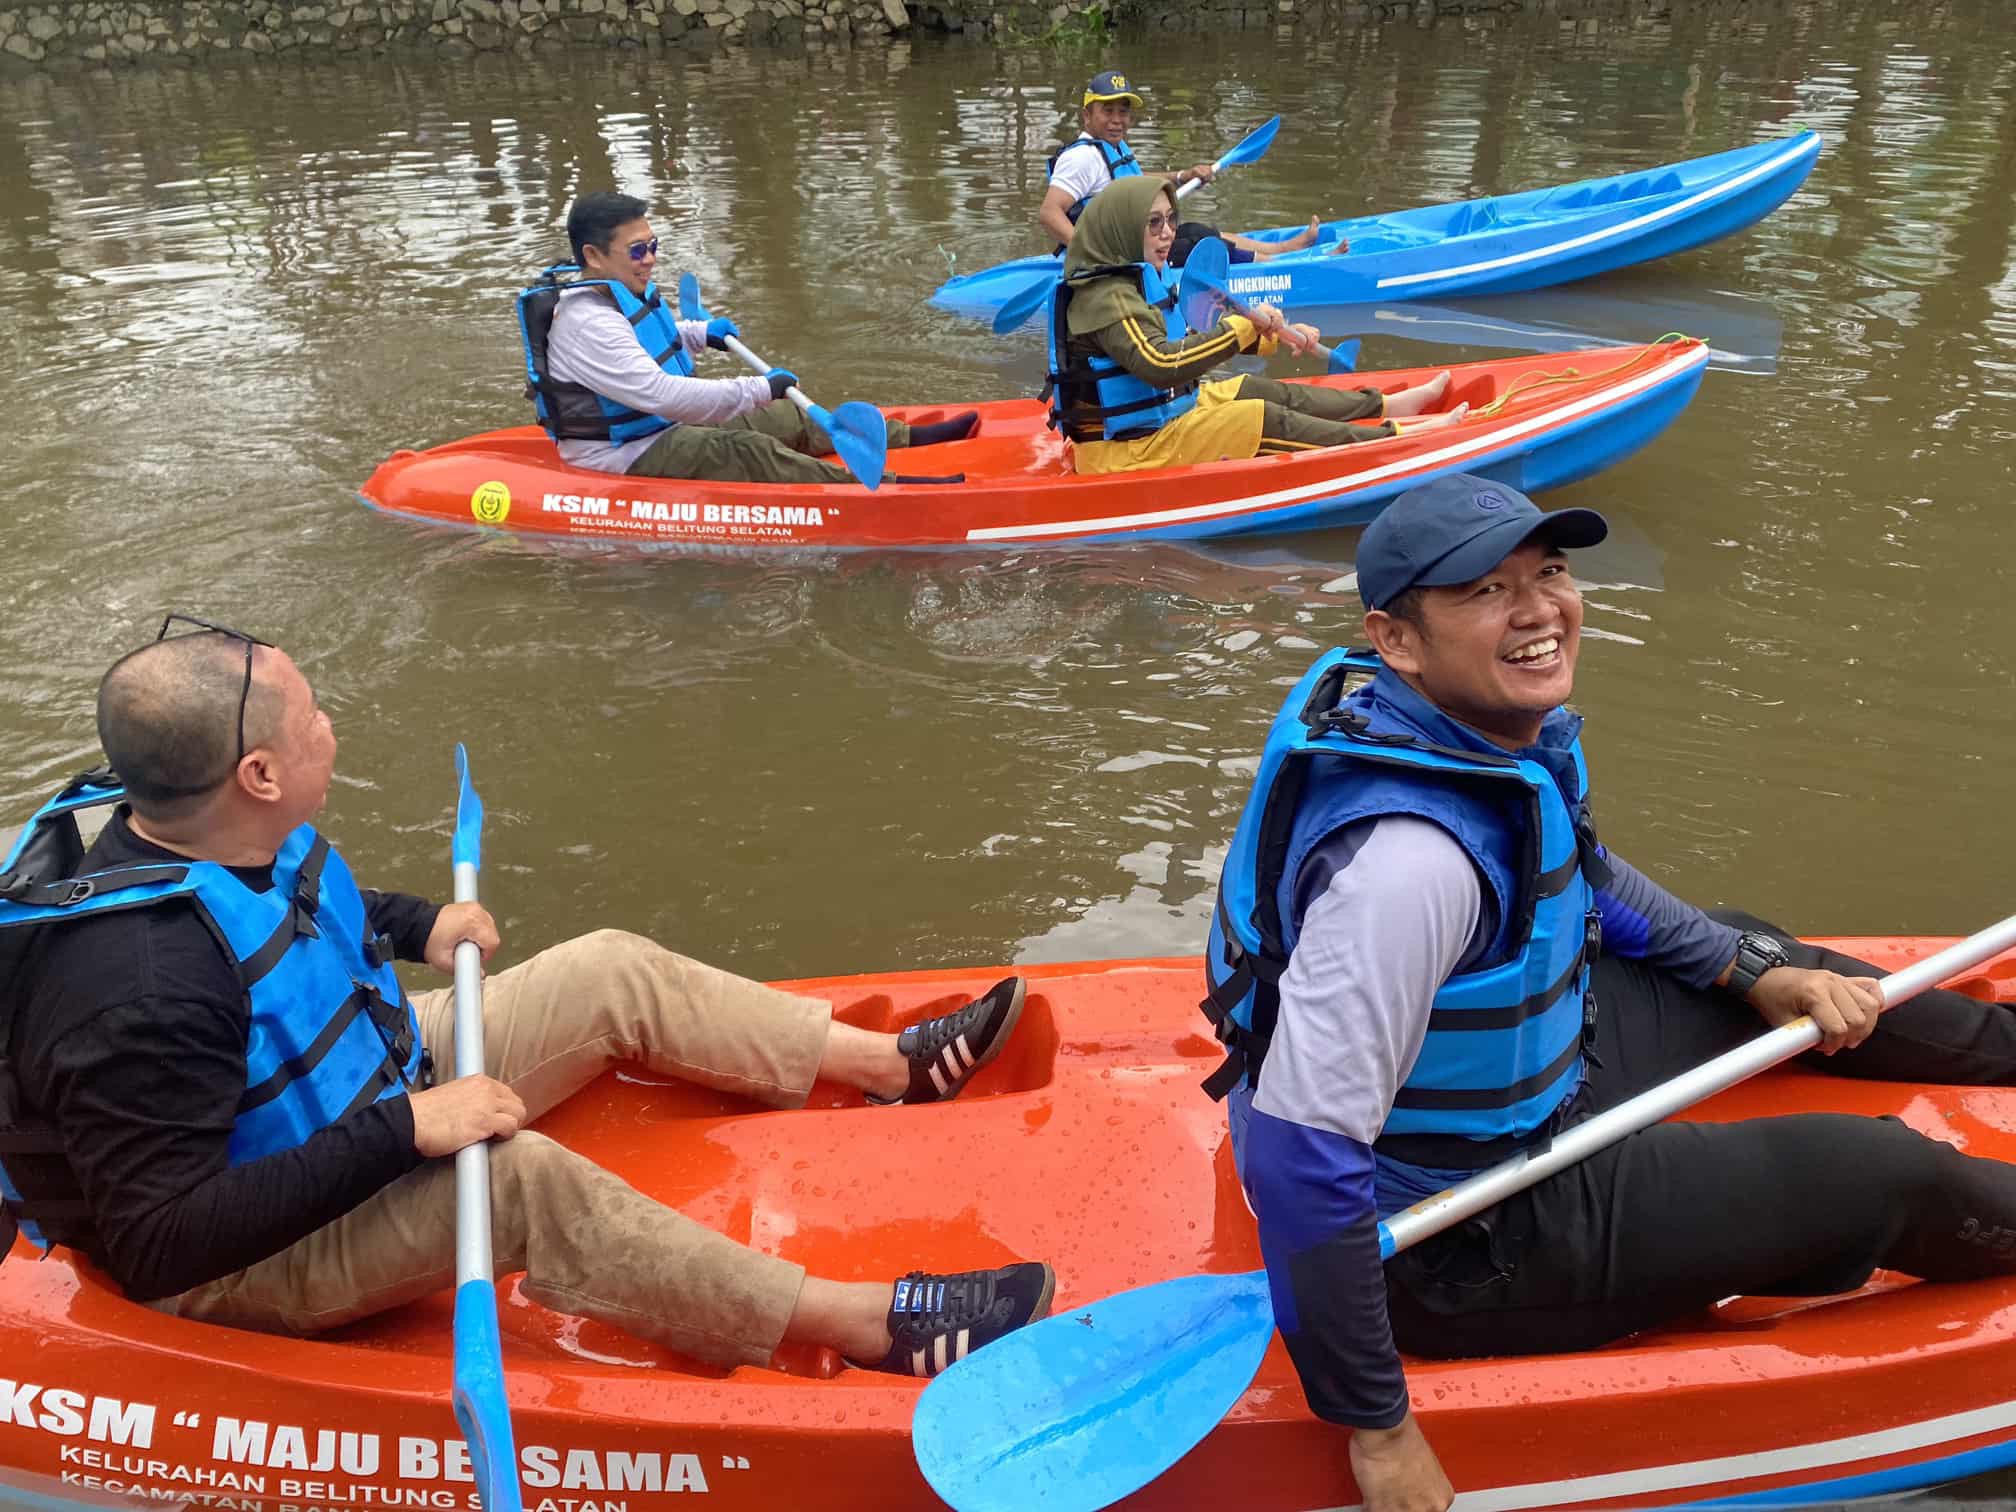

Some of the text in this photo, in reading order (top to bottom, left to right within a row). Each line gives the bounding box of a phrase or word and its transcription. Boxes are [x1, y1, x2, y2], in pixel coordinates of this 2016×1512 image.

[1229, 274, 1292, 293] LINGKUNGAN
[542, 493, 610, 516] KSM
[630, 500, 698, 522] MAJU
[703, 503, 824, 526] BERSAMA
[570, 516, 653, 530] KELURAHAN
[657, 523, 726, 534] BELITUNG
[730, 526, 792, 536] SELATAN
[0, 1378, 157, 1449] KSM
[212, 1416, 380, 1476] MAJU
[399, 1436, 709, 1493] BESAMA
[60, 1444, 627, 1512] KELURAHAN BELITUNG SATAN
[61, 1470, 263, 1512] KECAMATAN
